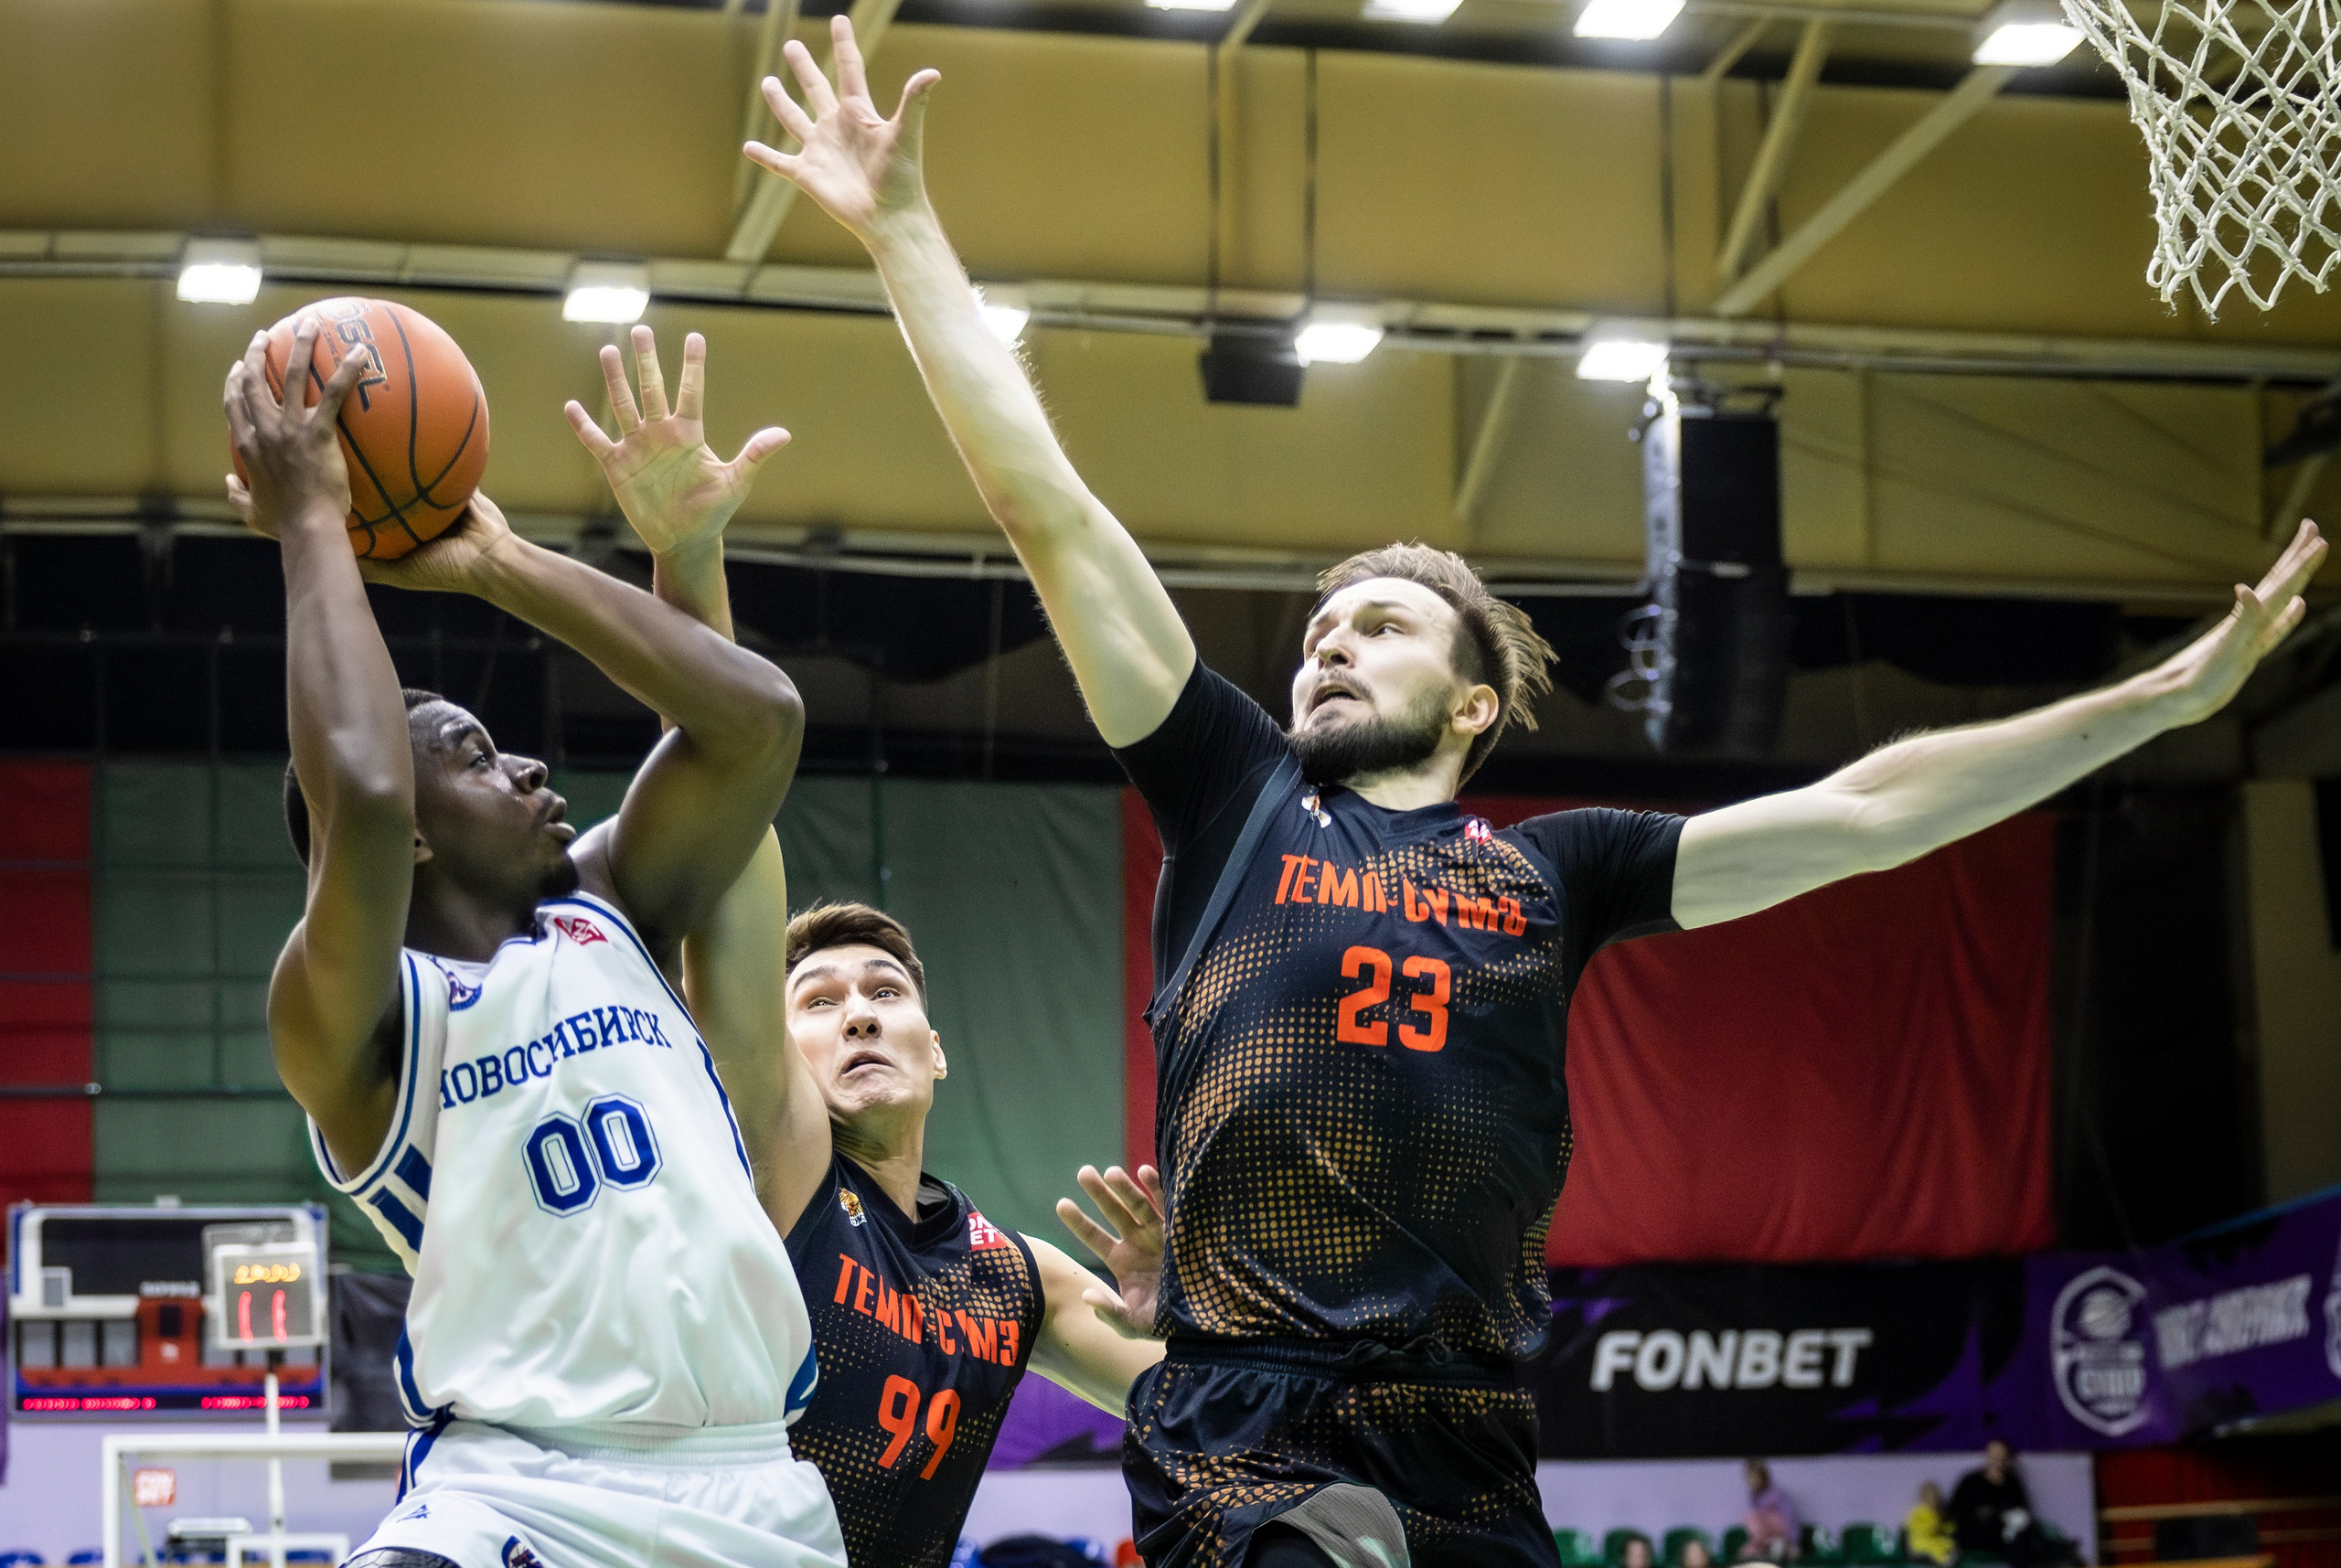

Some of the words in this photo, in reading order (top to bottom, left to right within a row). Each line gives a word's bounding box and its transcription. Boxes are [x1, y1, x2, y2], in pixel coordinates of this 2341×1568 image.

[1337, 945, 1451, 1052] 23
[521, 1093, 663, 1218] 00
[969, 1216, 993, 1232] ON
[970, 1229, 997, 1245] ET
[1589, 1328, 1874, 1392] FONBET
[878, 1374, 961, 1480] 99
